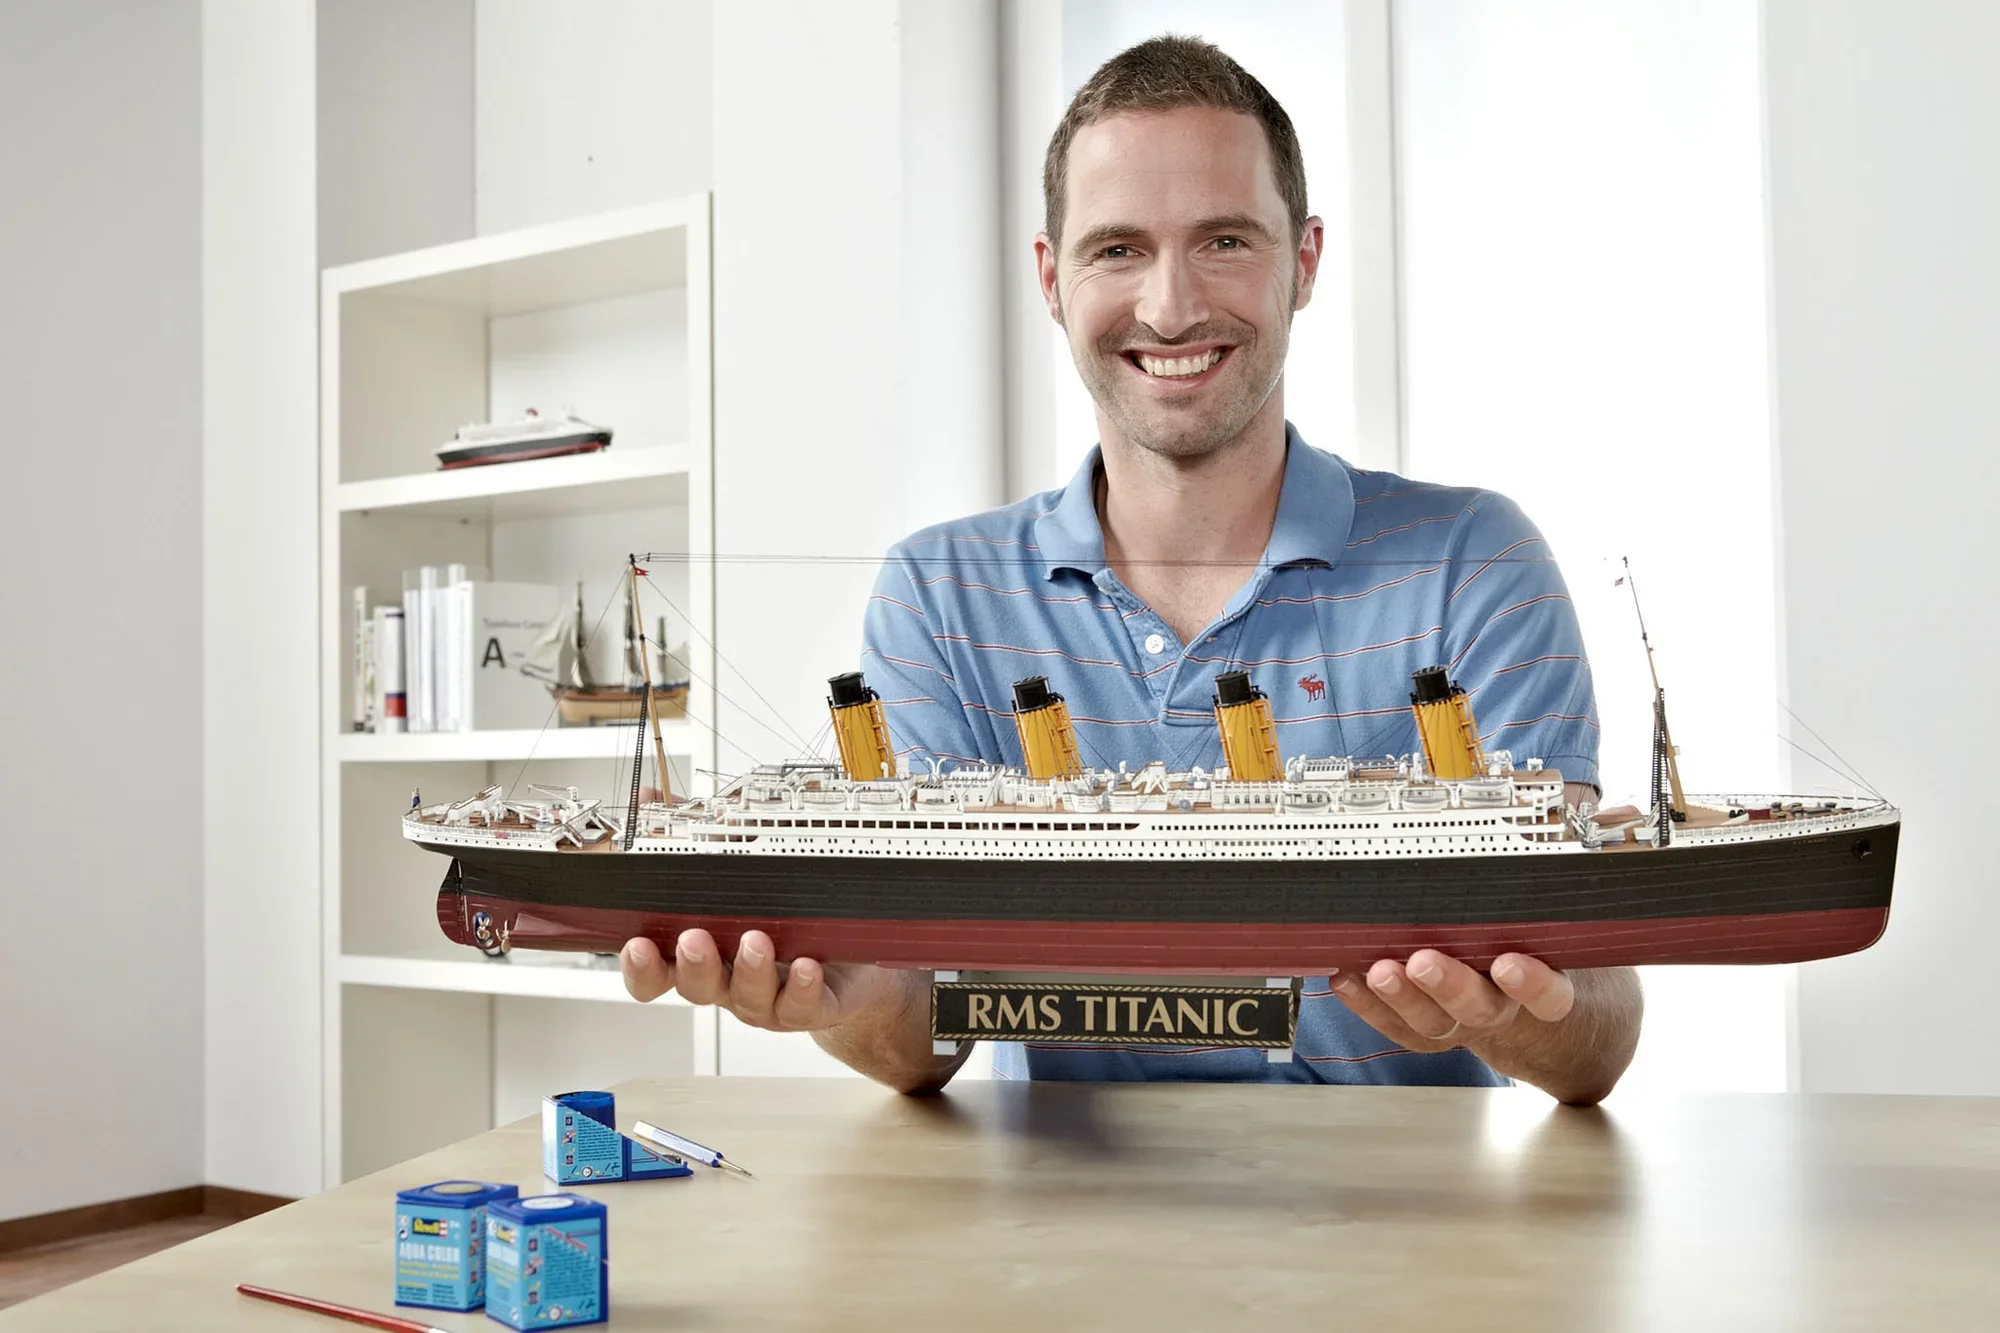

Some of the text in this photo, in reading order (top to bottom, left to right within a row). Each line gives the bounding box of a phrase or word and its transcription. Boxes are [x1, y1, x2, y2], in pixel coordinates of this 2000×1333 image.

[482, 638, 505, 667] A
[968, 993, 1259, 1036] RMS TITANIC
[427, 1245, 460, 1262] COLOR
